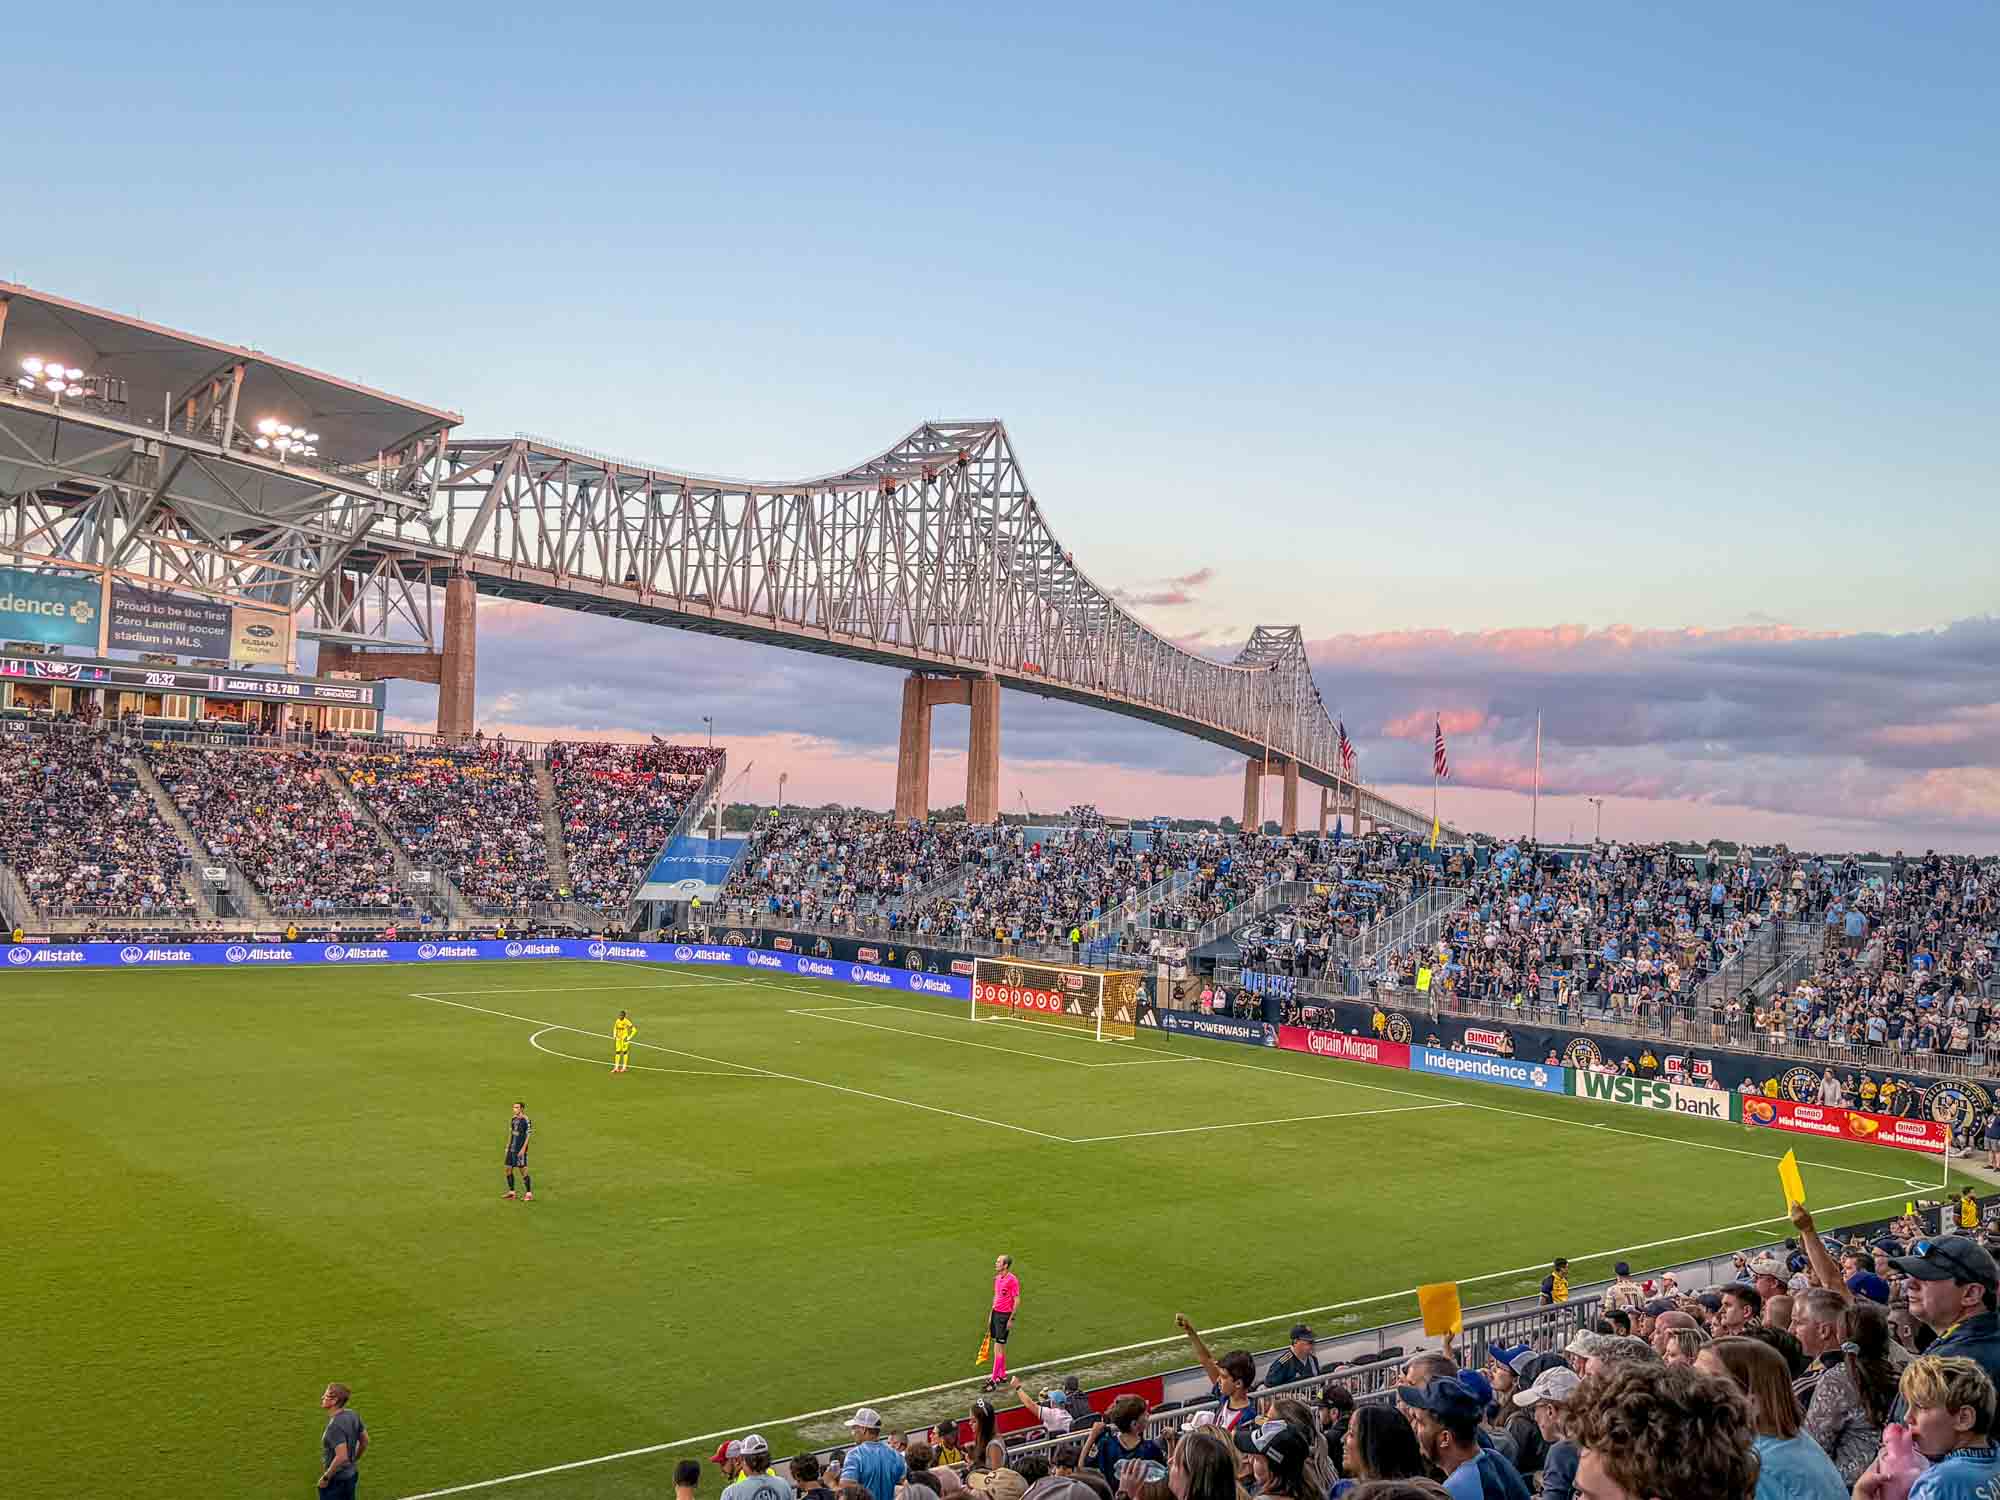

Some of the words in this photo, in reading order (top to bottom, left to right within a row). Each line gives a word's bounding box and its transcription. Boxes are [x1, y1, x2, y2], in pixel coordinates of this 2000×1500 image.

[116, 600, 151, 613] Proud
[153, 602, 165, 614] to
[167, 603, 182, 616] be
[184, 605, 201, 618] the
[203, 607, 226, 622] first
[115, 615, 142, 627] Zero
[145, 617, 186, 632] Landfill
[188, 623, 226, 636] soccer
[114, 631, 160, 643] stadium
[162, 635, 172, 644] in
[175, 636, 204, 648] MLS.
[145, 672, 175, 686] 20:32
[8, 722, 25, 731] 130
[210, 735, 224, 744] 131
[32, 949, 84, 961] Allstate
[143, 949, 192, 961] Allstate
[246, 948, 292, 960] Allstate
[344, 947, 388, 959] Allstate
[436, 946, 478, 957] Allstate
[523, 943, 561, 955] Allstate
[606, 946, 647, 958] Allstate
[692, 949, 731, 961] Allstate
[757, 954, 782, 967] Allstate
[808, 962, 833, 976] Allstate
[863, 970, 892, 983] Allstate
[922, 980, 952, 993] Allstate
[1193, 1021, 1249, 1038] POWERWASH
[1307, 1031, 1342, 1054] Captain
[1340, 1035, 1378, 1061] Morgan
[1424, 1051, 1527, 1081] Independence
[1582, 1070, 1673, 1109] WSFS
[1675, 1092, 1721, 1117] bank
[1778, 1116, 1795, 1126] Mini
[1877, 1131, 1895, 1141] Mini
